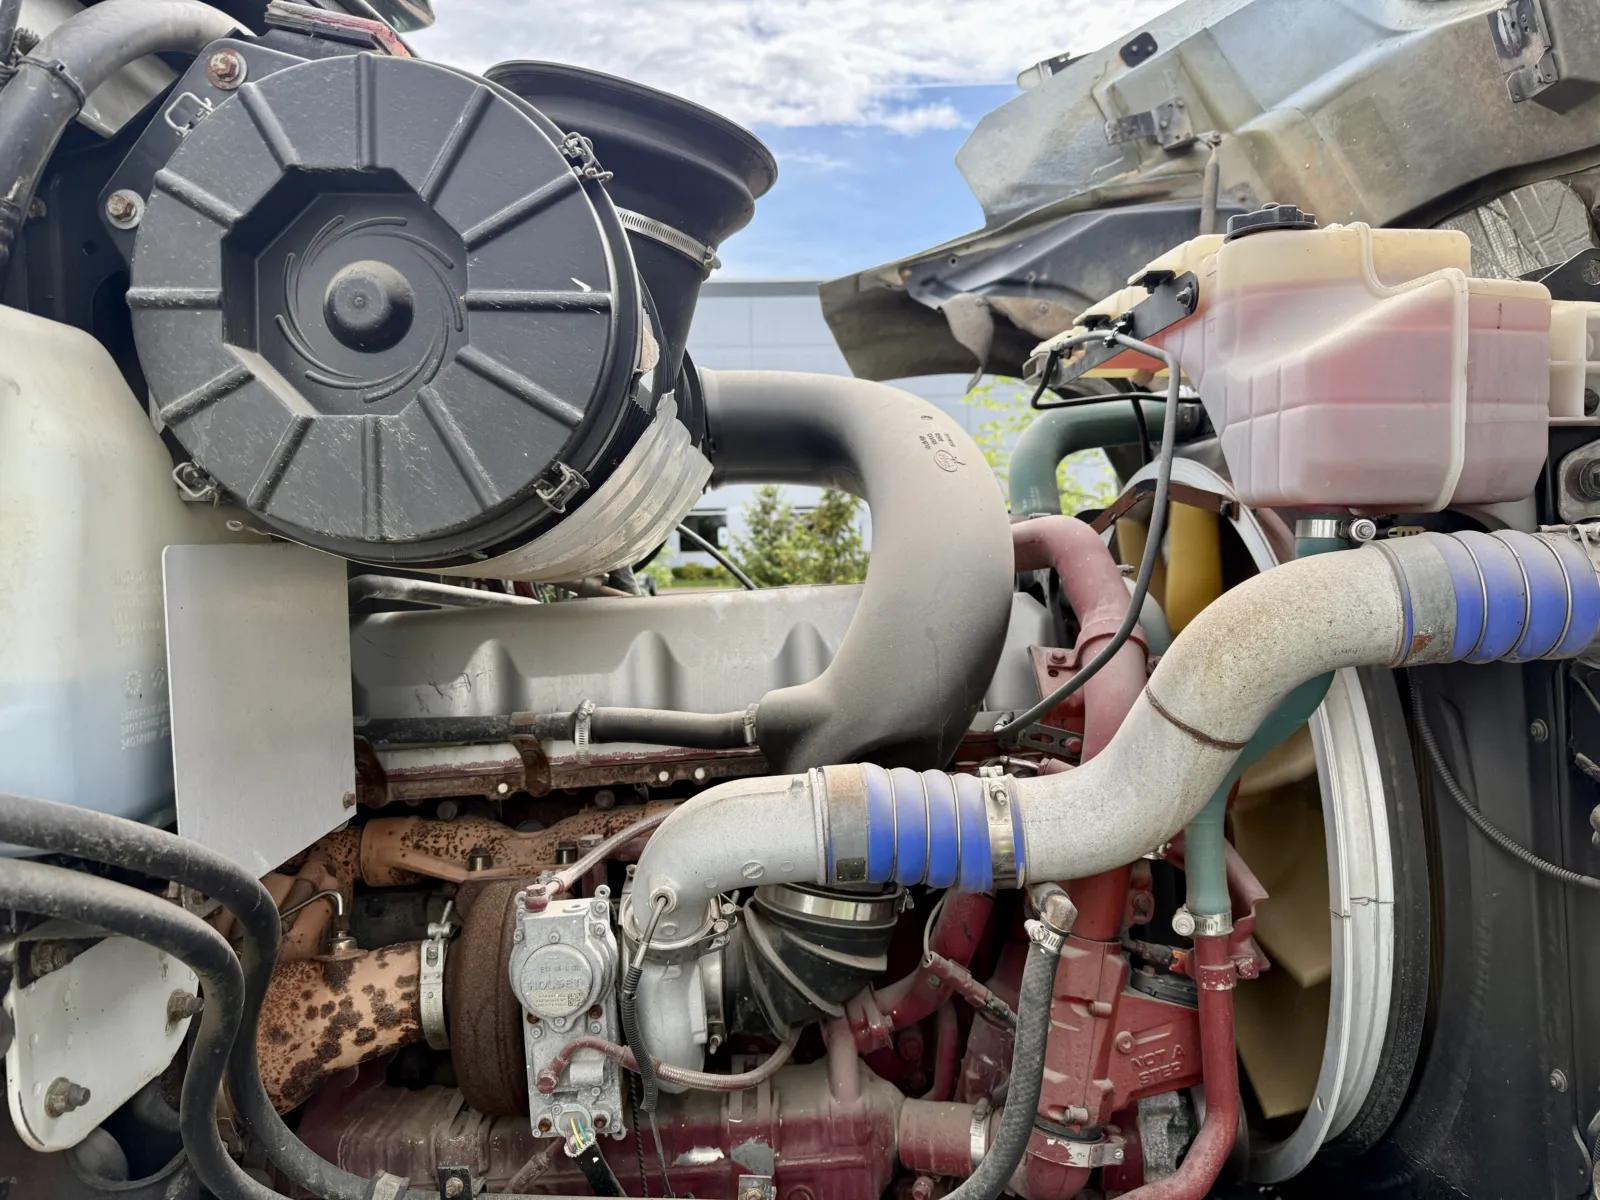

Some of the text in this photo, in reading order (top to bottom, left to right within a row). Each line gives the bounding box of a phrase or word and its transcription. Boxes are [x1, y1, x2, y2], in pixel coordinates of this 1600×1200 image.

[1130, 1044, 1185, 1068] NOT A
[1138, 1061, 1183, 1085] STEP
